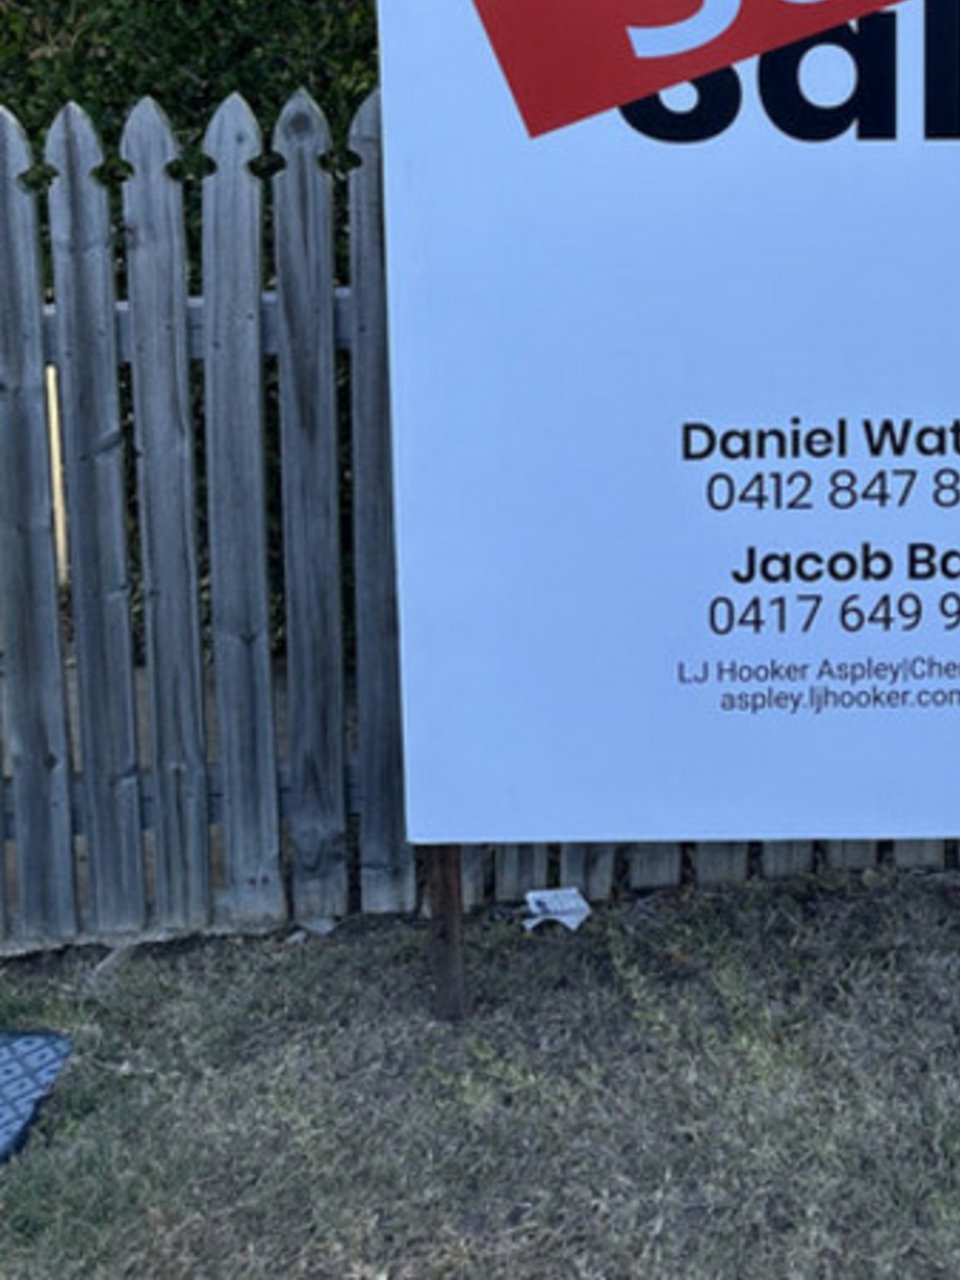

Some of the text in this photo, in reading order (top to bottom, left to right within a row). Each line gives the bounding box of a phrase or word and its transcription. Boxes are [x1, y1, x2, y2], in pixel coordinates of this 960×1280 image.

[681, 416, 848, 462] Daniel
[706, 471, 814, 512] 0412
[827, 468, 918, 511] 847
[730, 541, 894, 585] Jacob
[708, 594, 823, 636] 0417
[838, 592, 923, 634] 649
[677, 661, 709, 684] LJ
[716, 658, 809, 683] Hooker
